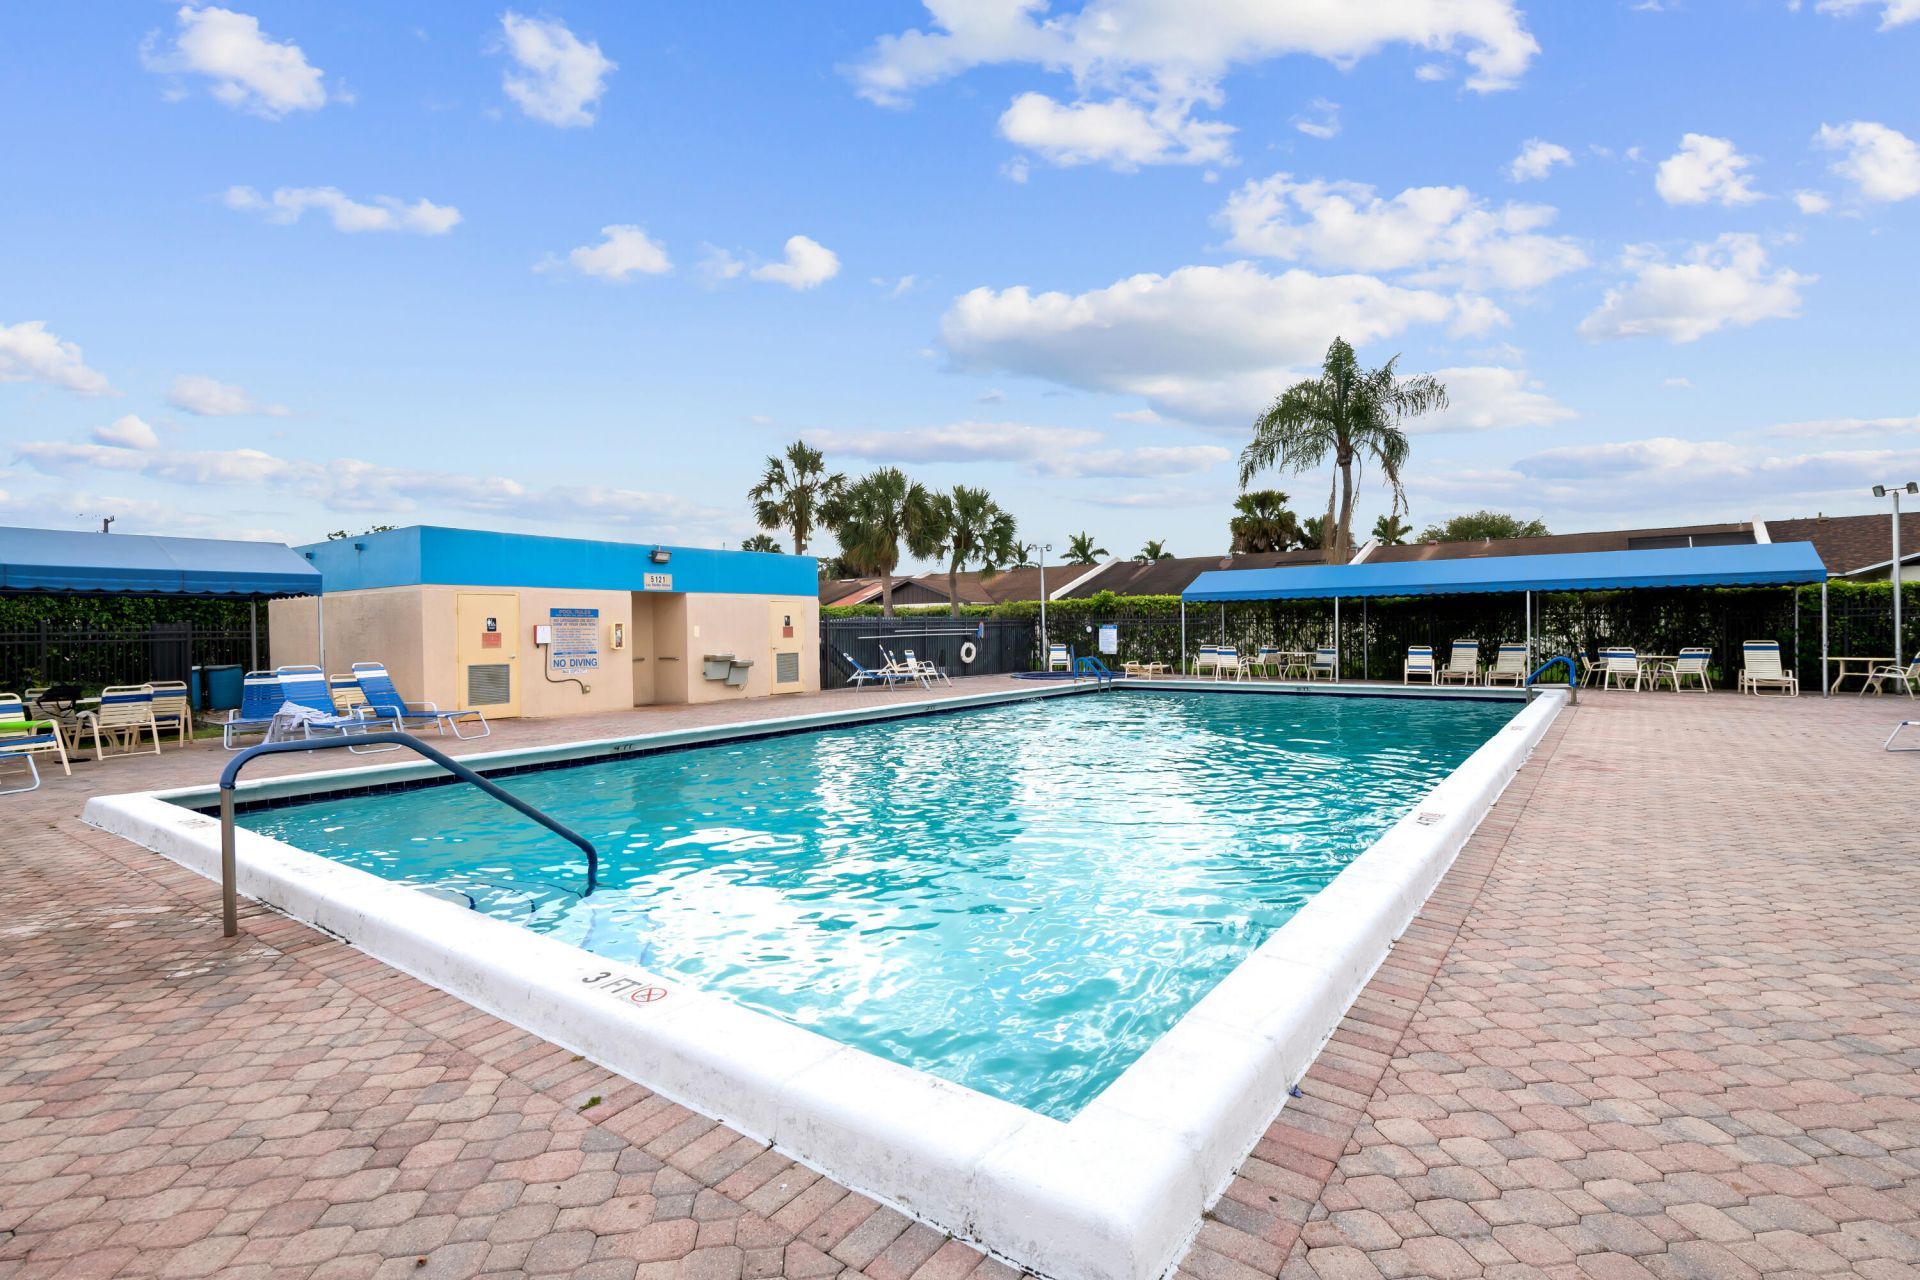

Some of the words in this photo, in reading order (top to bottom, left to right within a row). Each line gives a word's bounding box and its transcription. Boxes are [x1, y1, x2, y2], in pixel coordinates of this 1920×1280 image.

[650, 575, 666, 583] 5121
[553, 659, 566, 667] NO
[570, 658, 598, 667] DIVING
[582, 972, 611, 983] 3
[600, 978, 642, 993] FT
